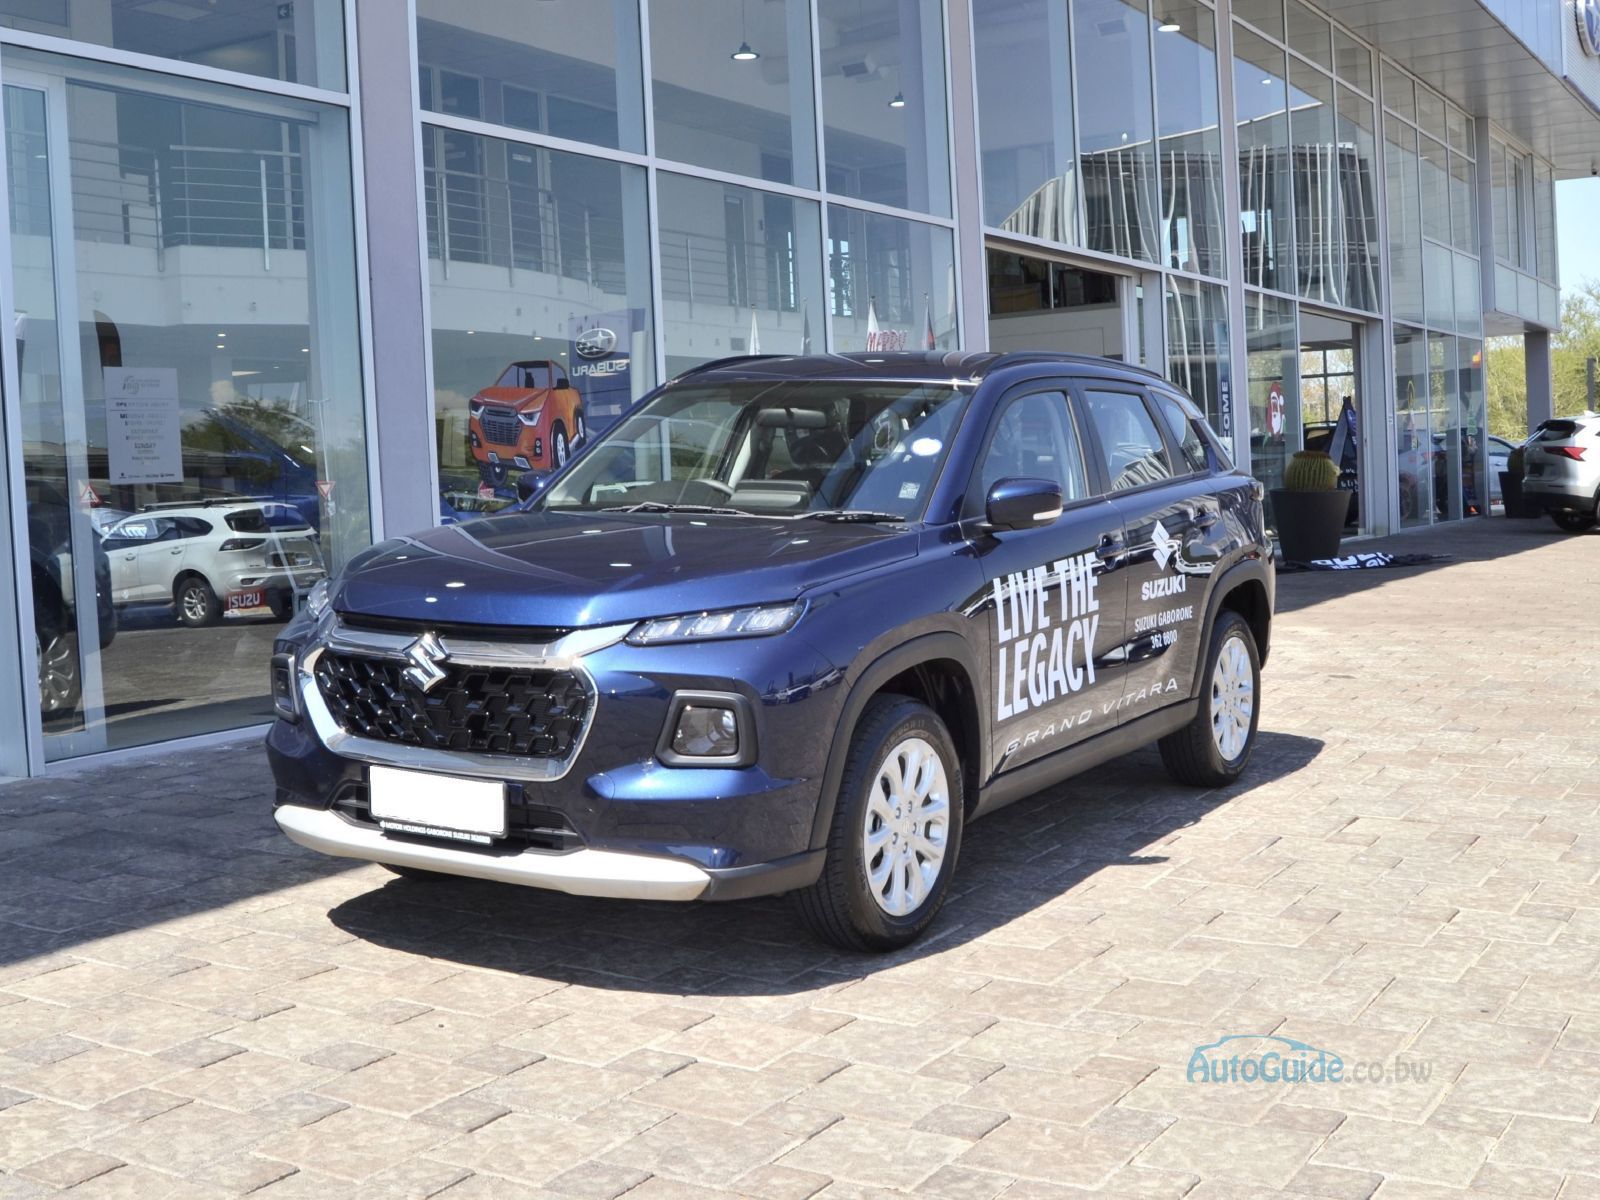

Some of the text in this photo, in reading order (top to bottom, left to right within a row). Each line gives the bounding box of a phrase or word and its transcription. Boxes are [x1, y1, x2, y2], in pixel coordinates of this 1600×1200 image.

[228, 592, 261, 609] ISUZU
[993, 552, 1100, 644] LIVE THE
[1141, 574, 1186, 600] SUZUKI
[1134, 605, 1193, 632] SUZUKI GABORONE
[997, 614, 1099, 721] LEGACY
[1005, 677, 1178, 756] GRAND VITARA
